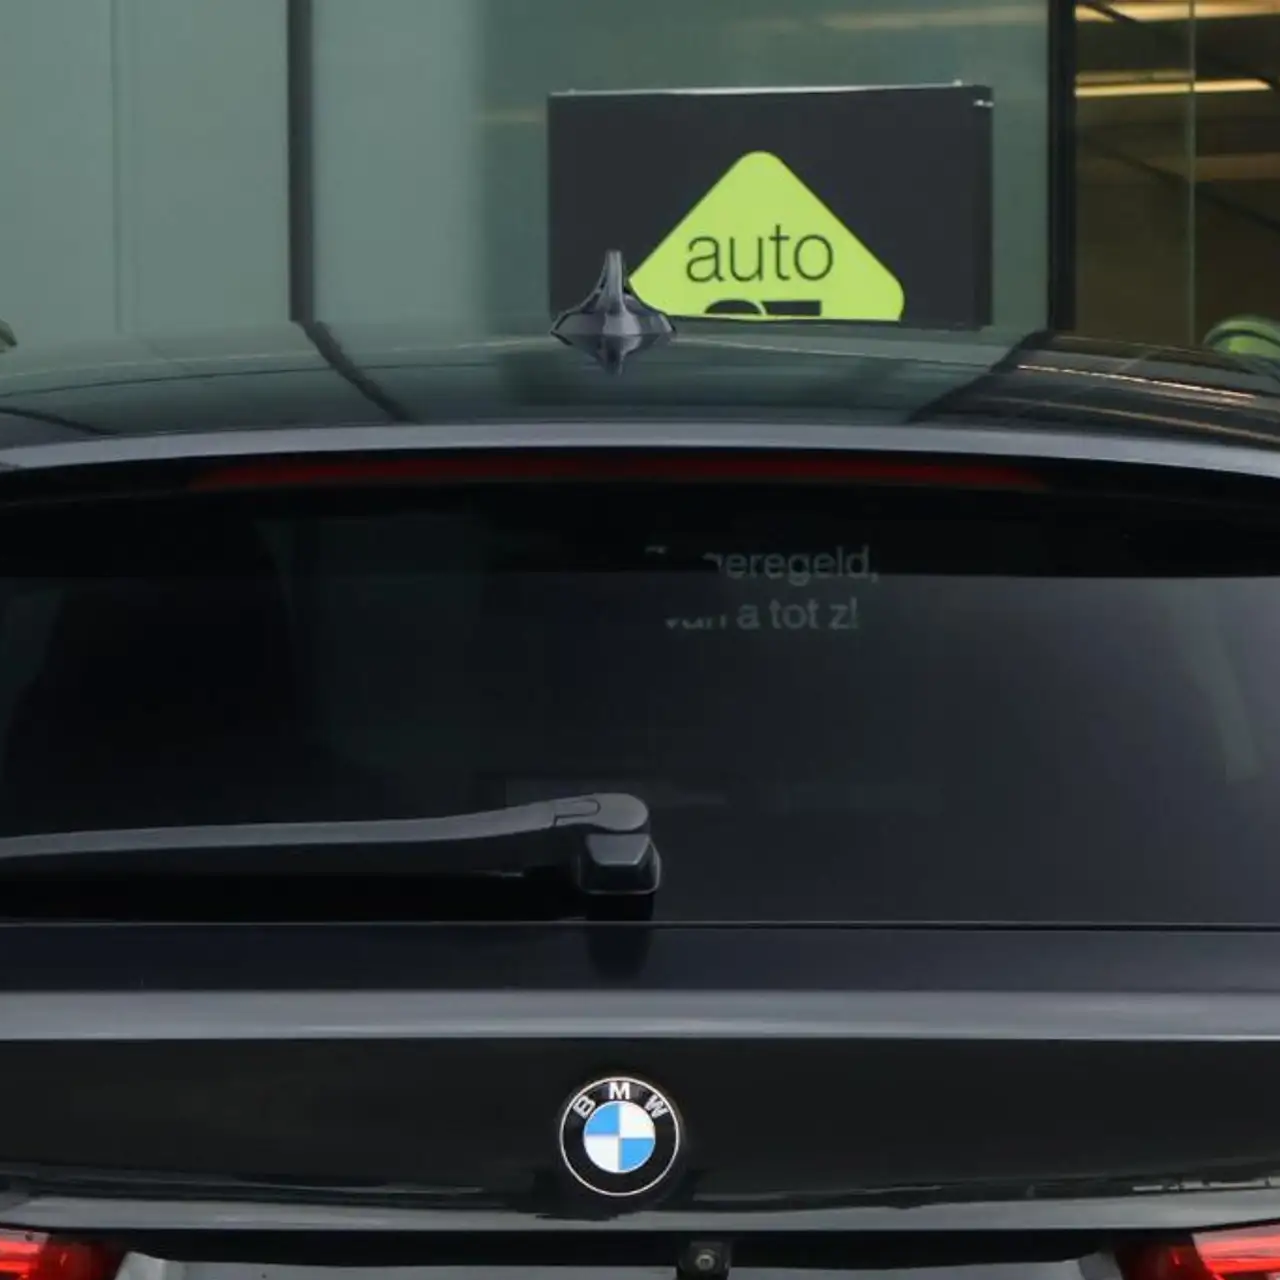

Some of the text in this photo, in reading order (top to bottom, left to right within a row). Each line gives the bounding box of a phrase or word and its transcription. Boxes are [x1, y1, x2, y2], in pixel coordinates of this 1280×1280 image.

[685, 223, 835, 283] auto
[736, 603, 761, 630] a
[769, 597, 820, 630] tot
[572, 1081, 670, 1119] BMW
